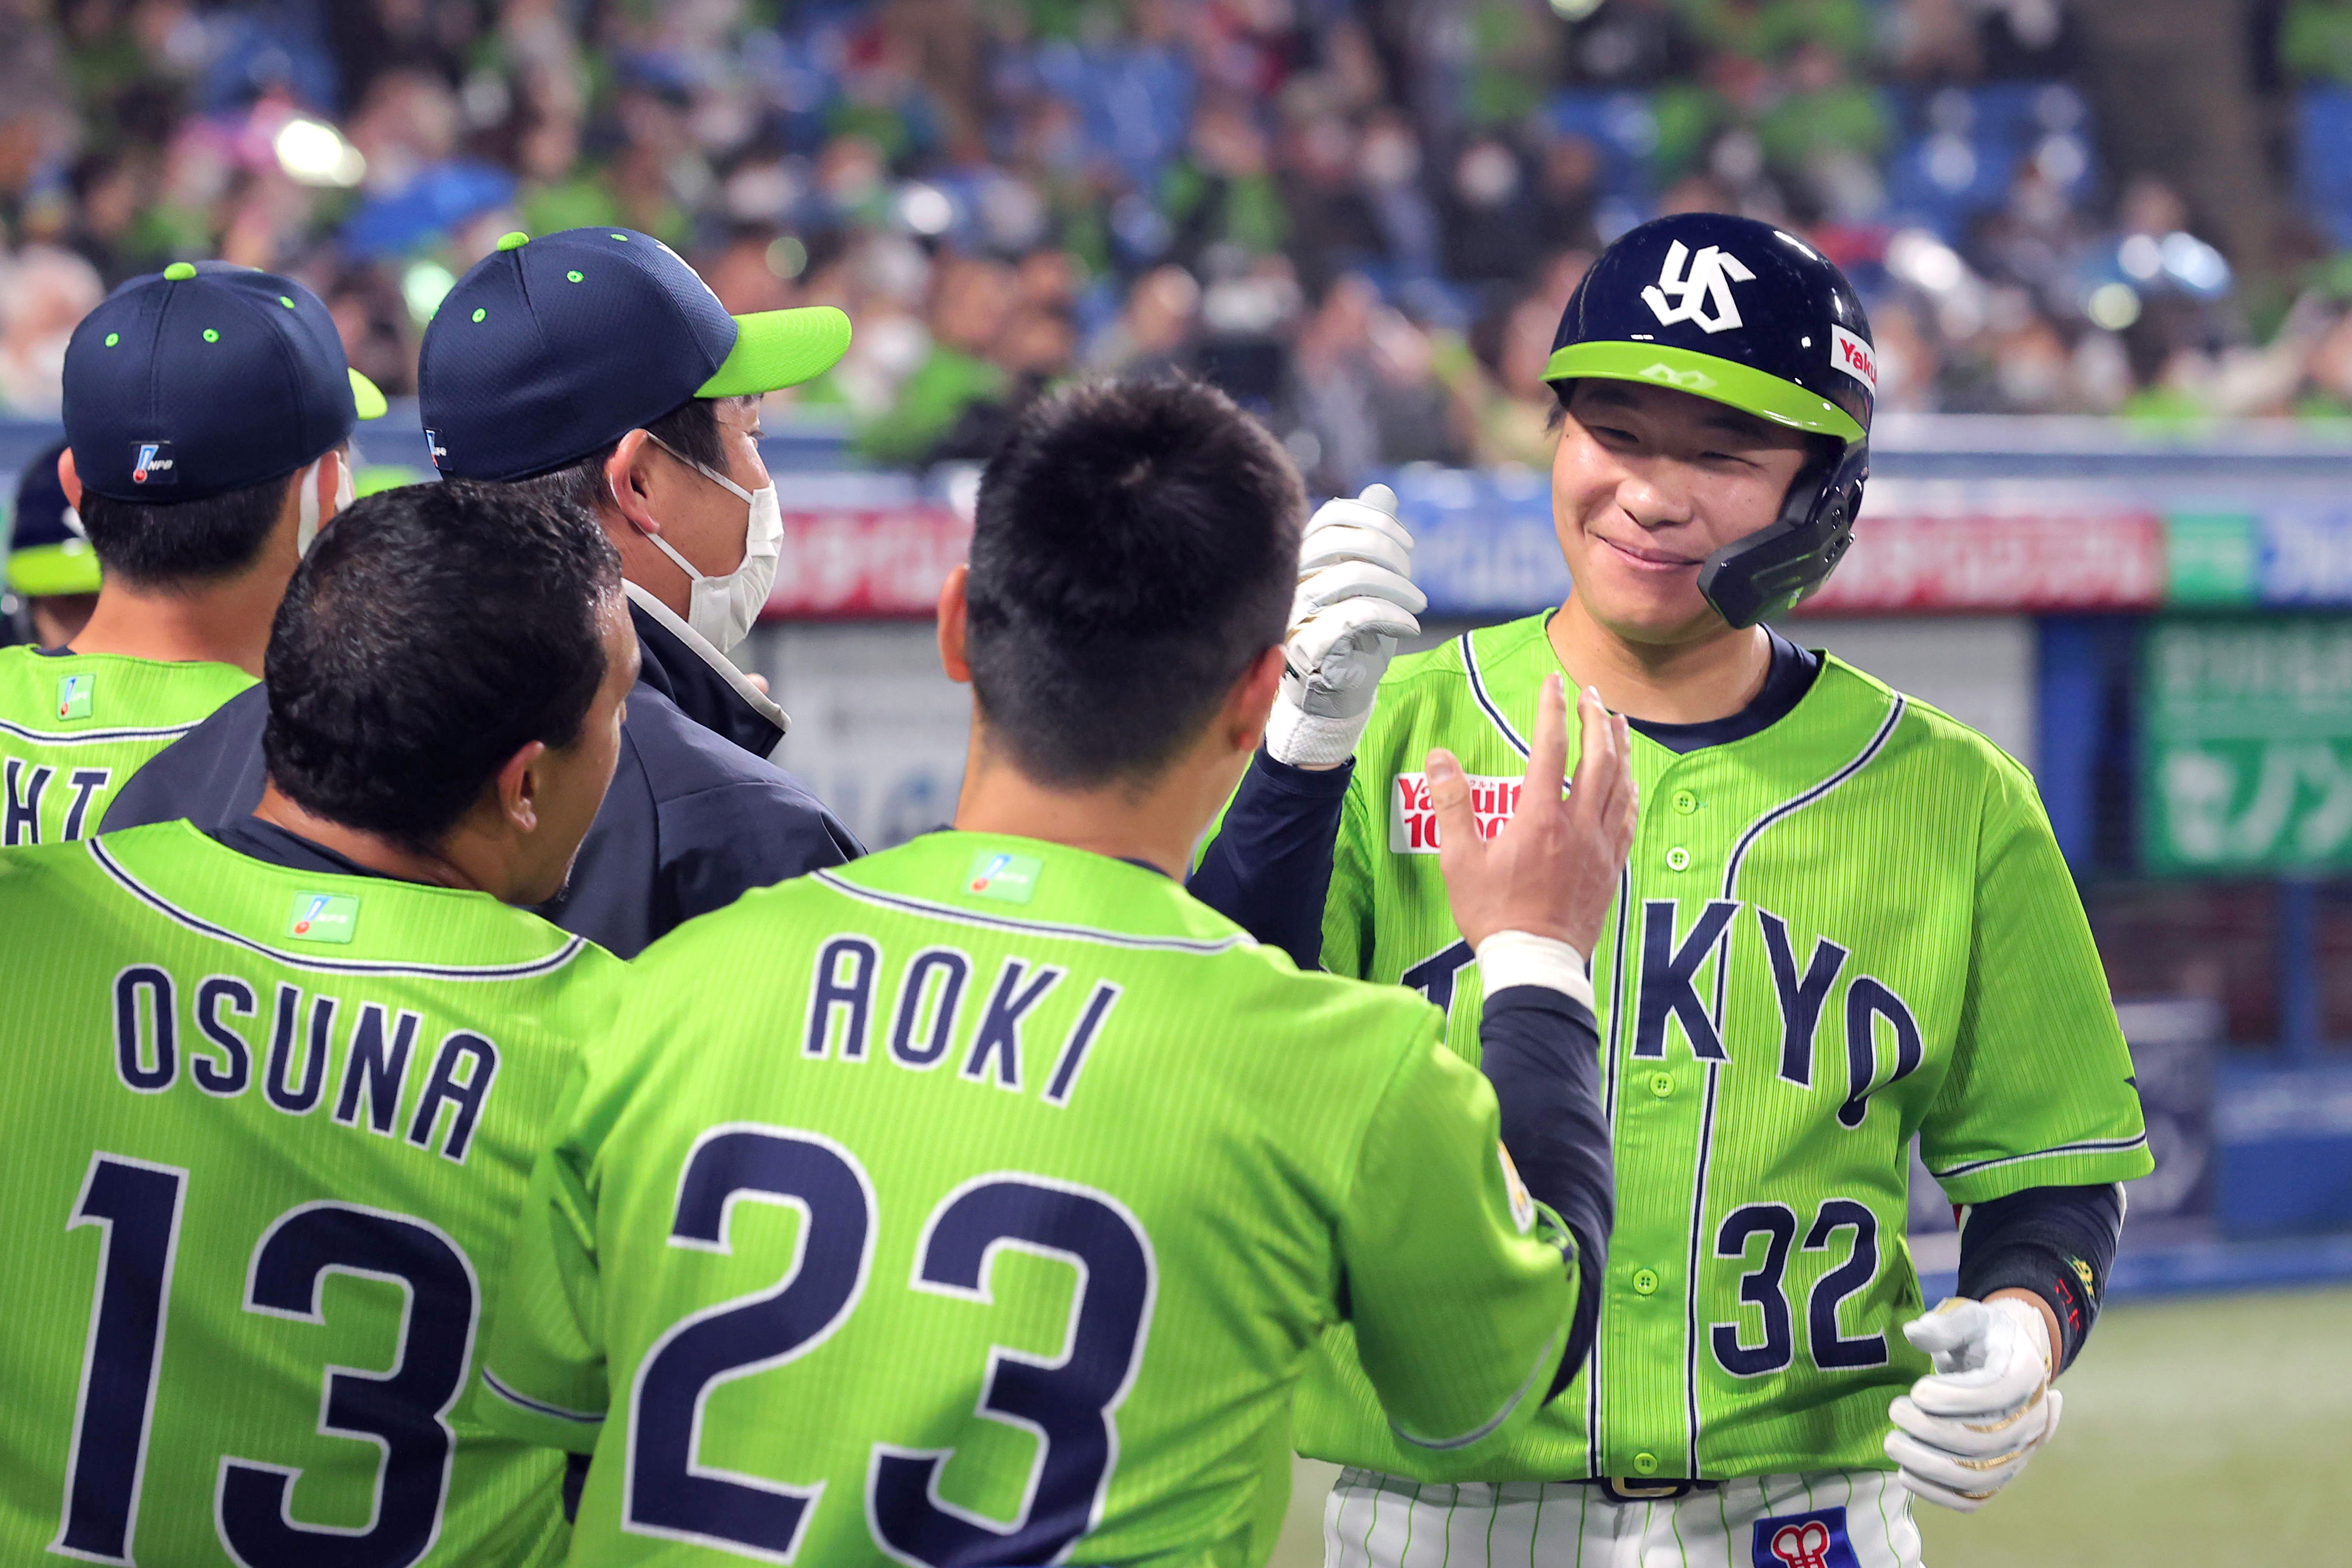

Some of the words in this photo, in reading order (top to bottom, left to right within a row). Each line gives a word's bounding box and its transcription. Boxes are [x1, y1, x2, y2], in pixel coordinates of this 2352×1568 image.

[1398, 778, 1522, 814] Yault
[112, 963, 500, 1165] OSUNA
[801, 932, 1125, 1110] AOKI
[46, 1150, 481, 1568] 13
[620, 1120, 1159, 1568] 23
[1709, 1197, 1889, 1379] 32
